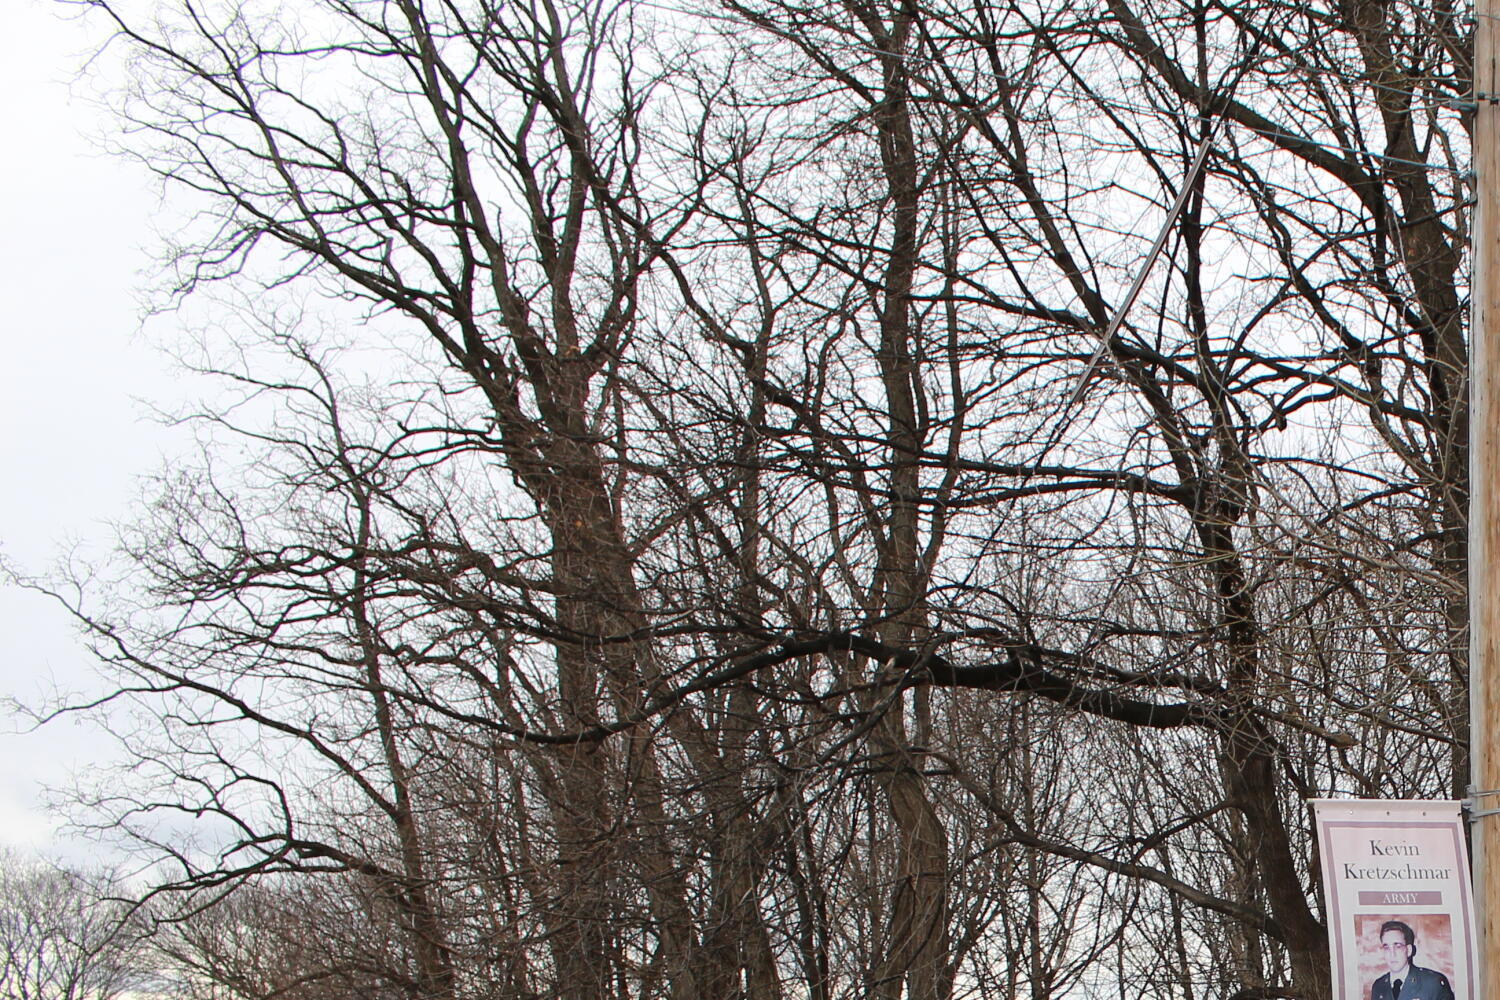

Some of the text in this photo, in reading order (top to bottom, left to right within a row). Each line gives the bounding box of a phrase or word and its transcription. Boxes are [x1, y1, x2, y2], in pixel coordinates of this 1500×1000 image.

[1369, 840, 1420, 856] Kevin
[1344, 863, 1451, 880] Kretzschmar
[1382, 893, 1418, 904] ARMY
